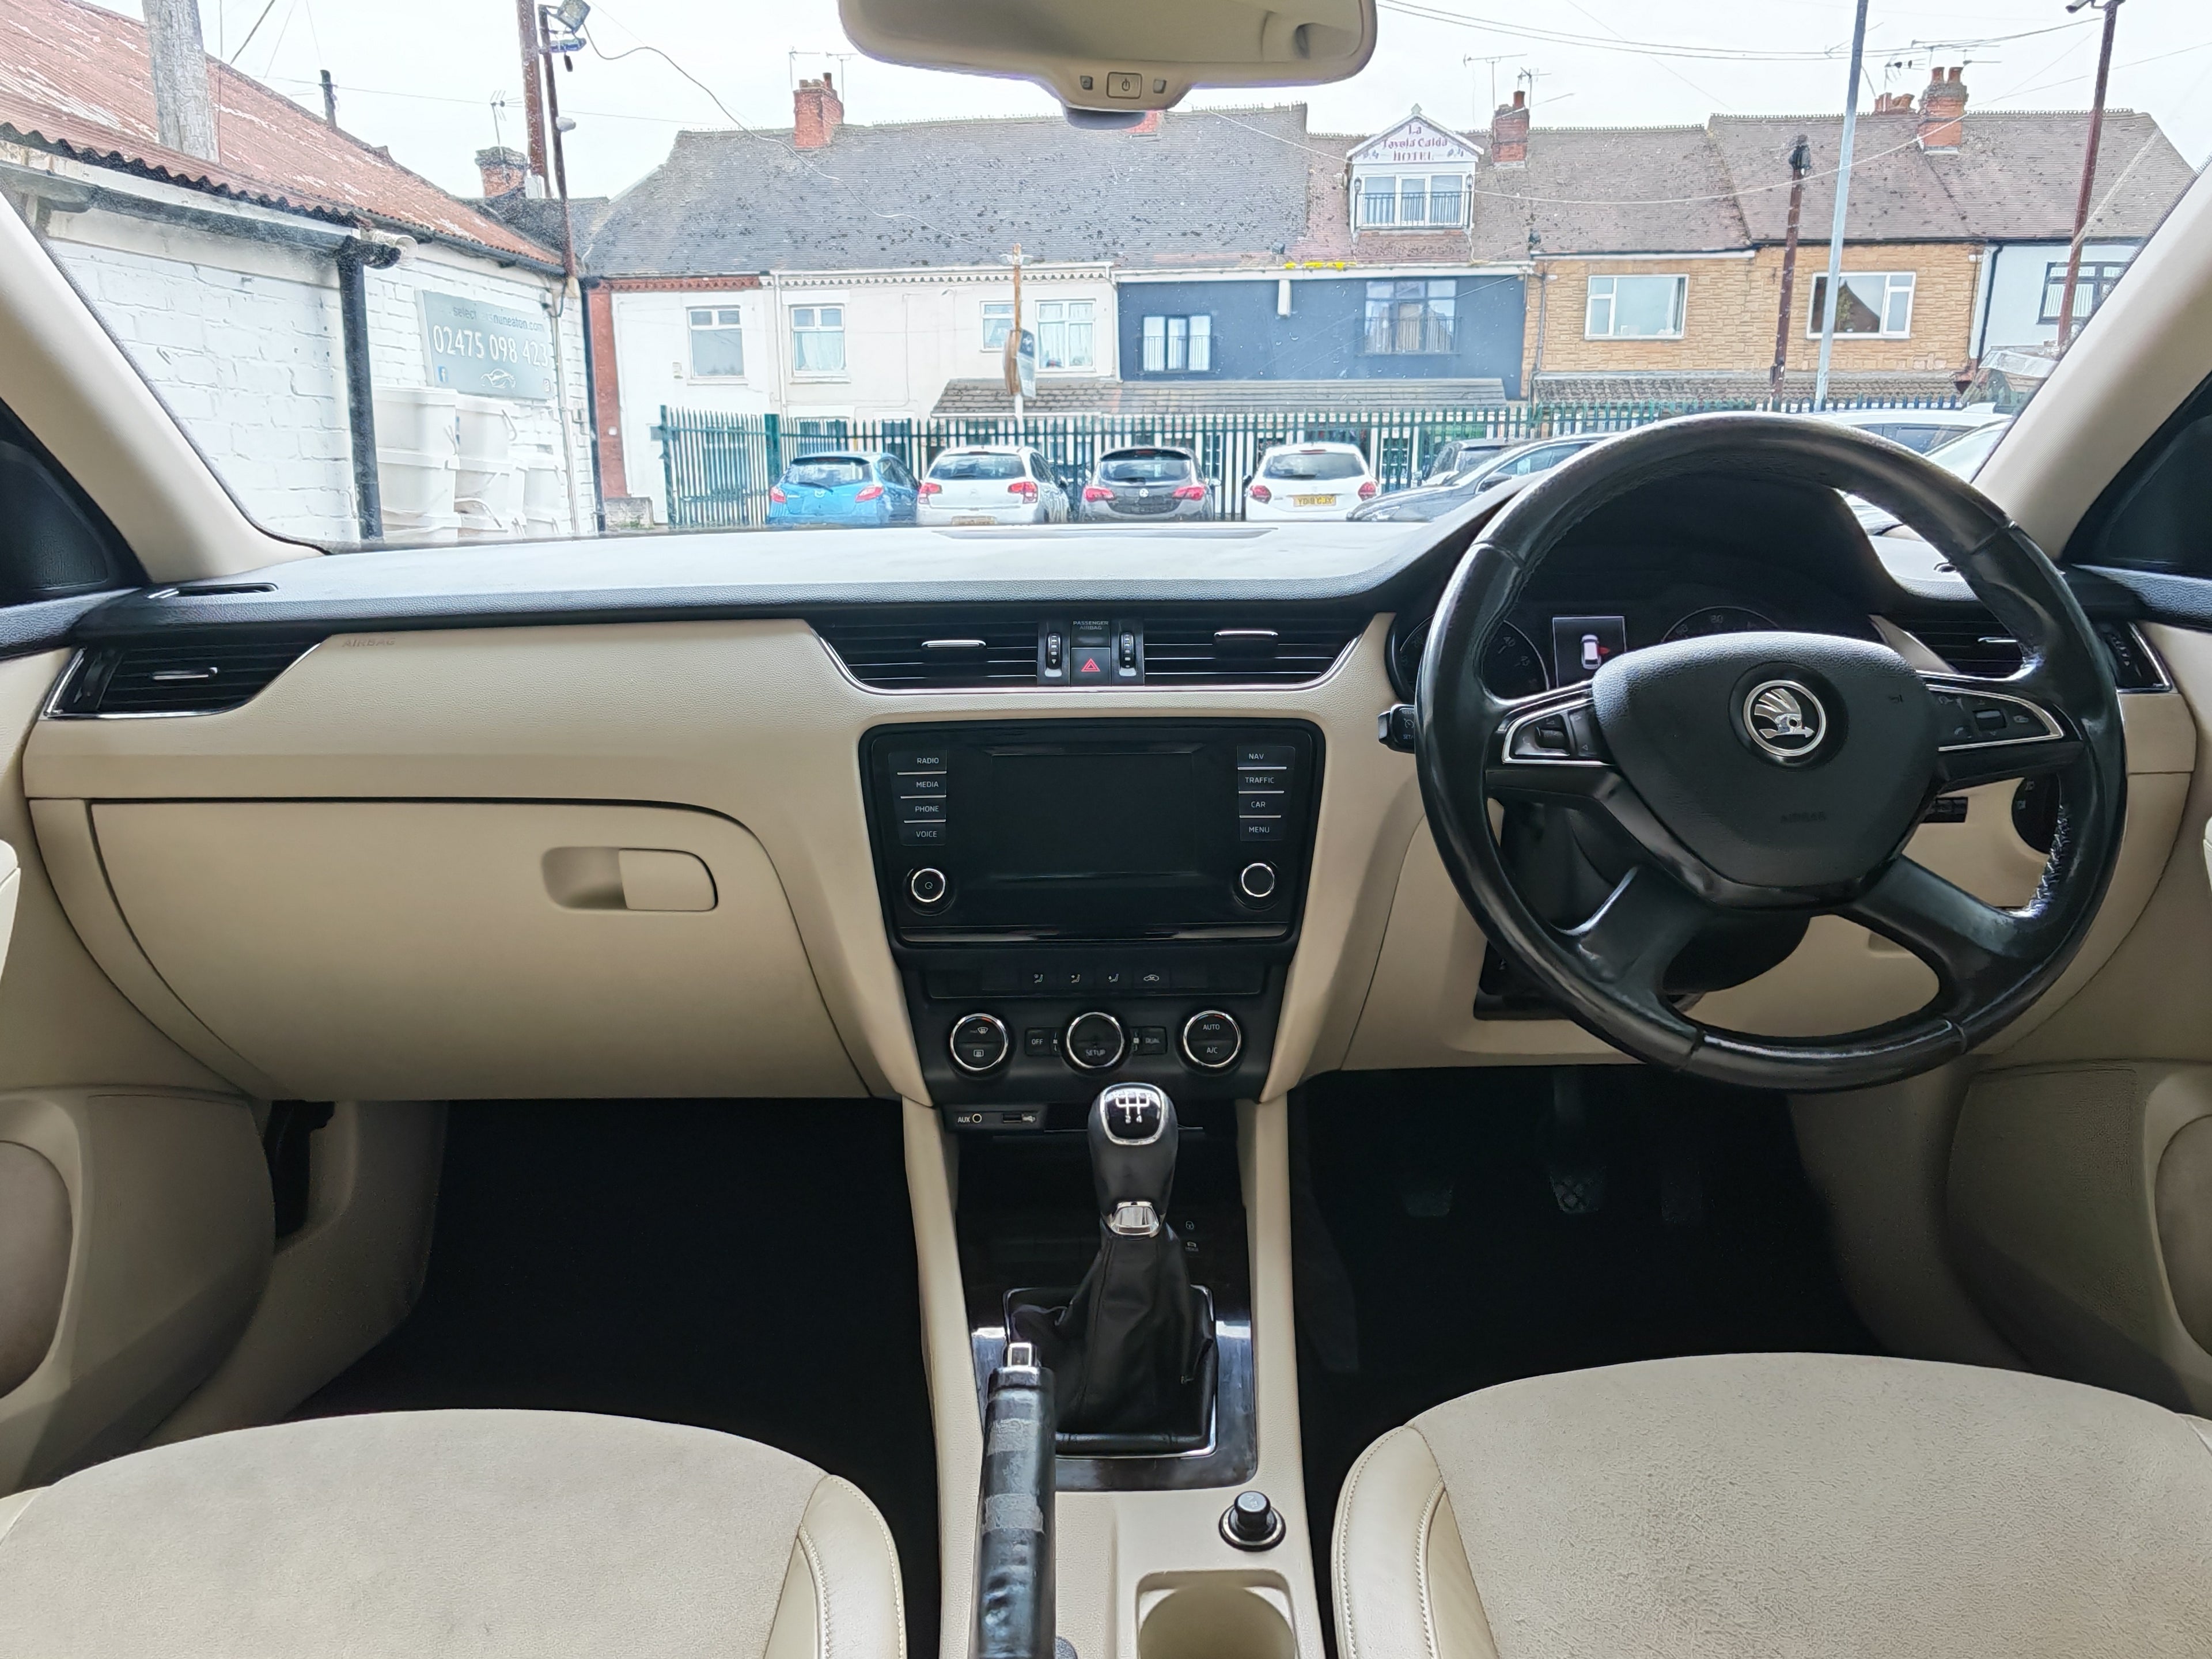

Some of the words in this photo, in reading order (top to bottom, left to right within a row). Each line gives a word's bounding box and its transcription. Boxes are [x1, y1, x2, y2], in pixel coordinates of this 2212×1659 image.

[1408, 124, 1422, 135] La
[1393, 150, 1434, 161] HOTEL
[433, 324, 485, 359] 02475
[489, 334, 518, 363] 098
[522, 339, 548, 367] 423
